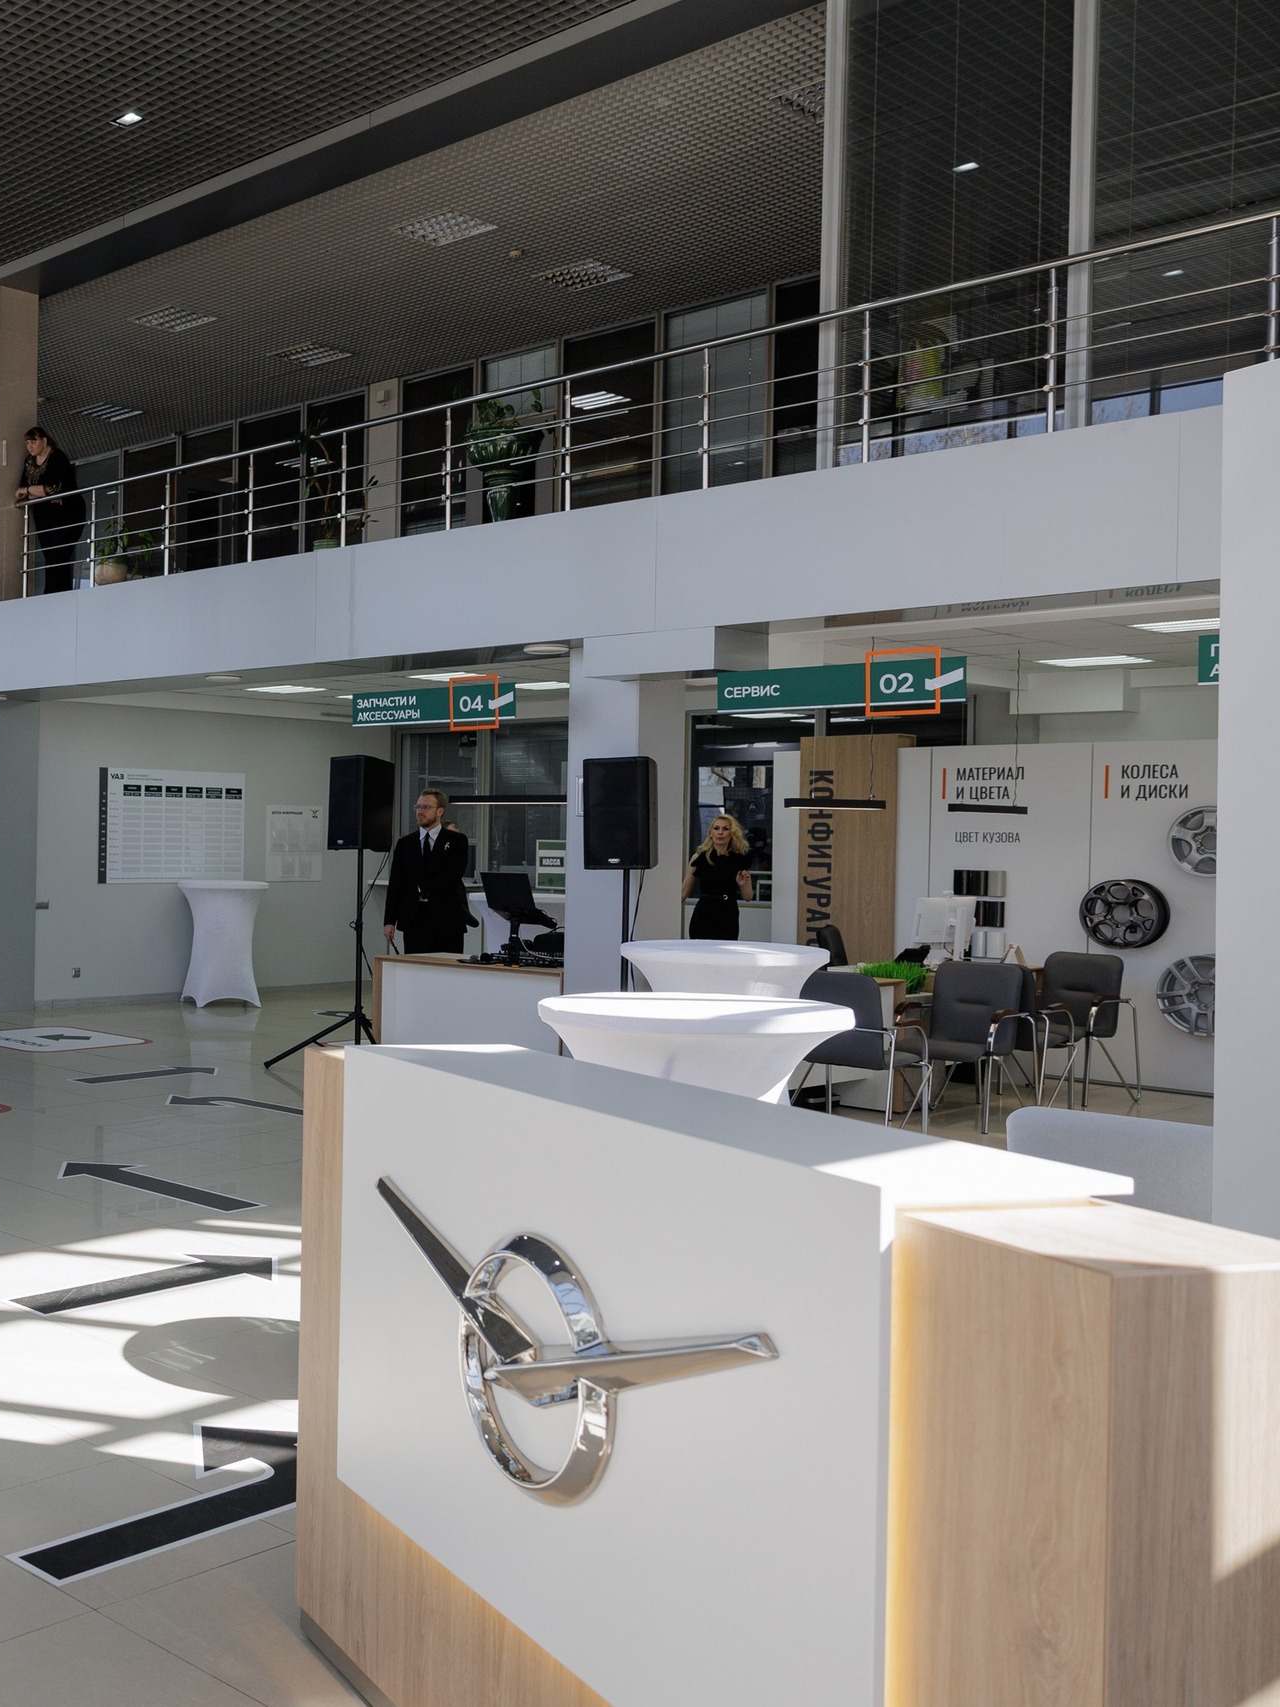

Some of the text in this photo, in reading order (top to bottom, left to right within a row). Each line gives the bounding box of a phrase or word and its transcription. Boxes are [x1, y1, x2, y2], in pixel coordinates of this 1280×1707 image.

[879, 672, 914, 694] 02
[723, 684, 781, 699] СЕРВИС
[356, 695, 417, 709] ЗАПЧАСТИ И
[459, 695, 483, 713] 04
[356, 709, 420, 722] АКСЕССУАРЫ
[956, 766, 1025, 781] МАТЕРИАЛ
[1121, 764, 1179, 779] КОЛЕСА
[955, 785, 1010, 801] И ЦВЕТА
[1120, 784, 1189, 801] И ДИСКИ
[954, 831, 1021, 844] ЦВЕТ КУЗОВА
[542, 858, 561, 866] КАССА
[803, 770, 834, 948] КОНФИГУРА
